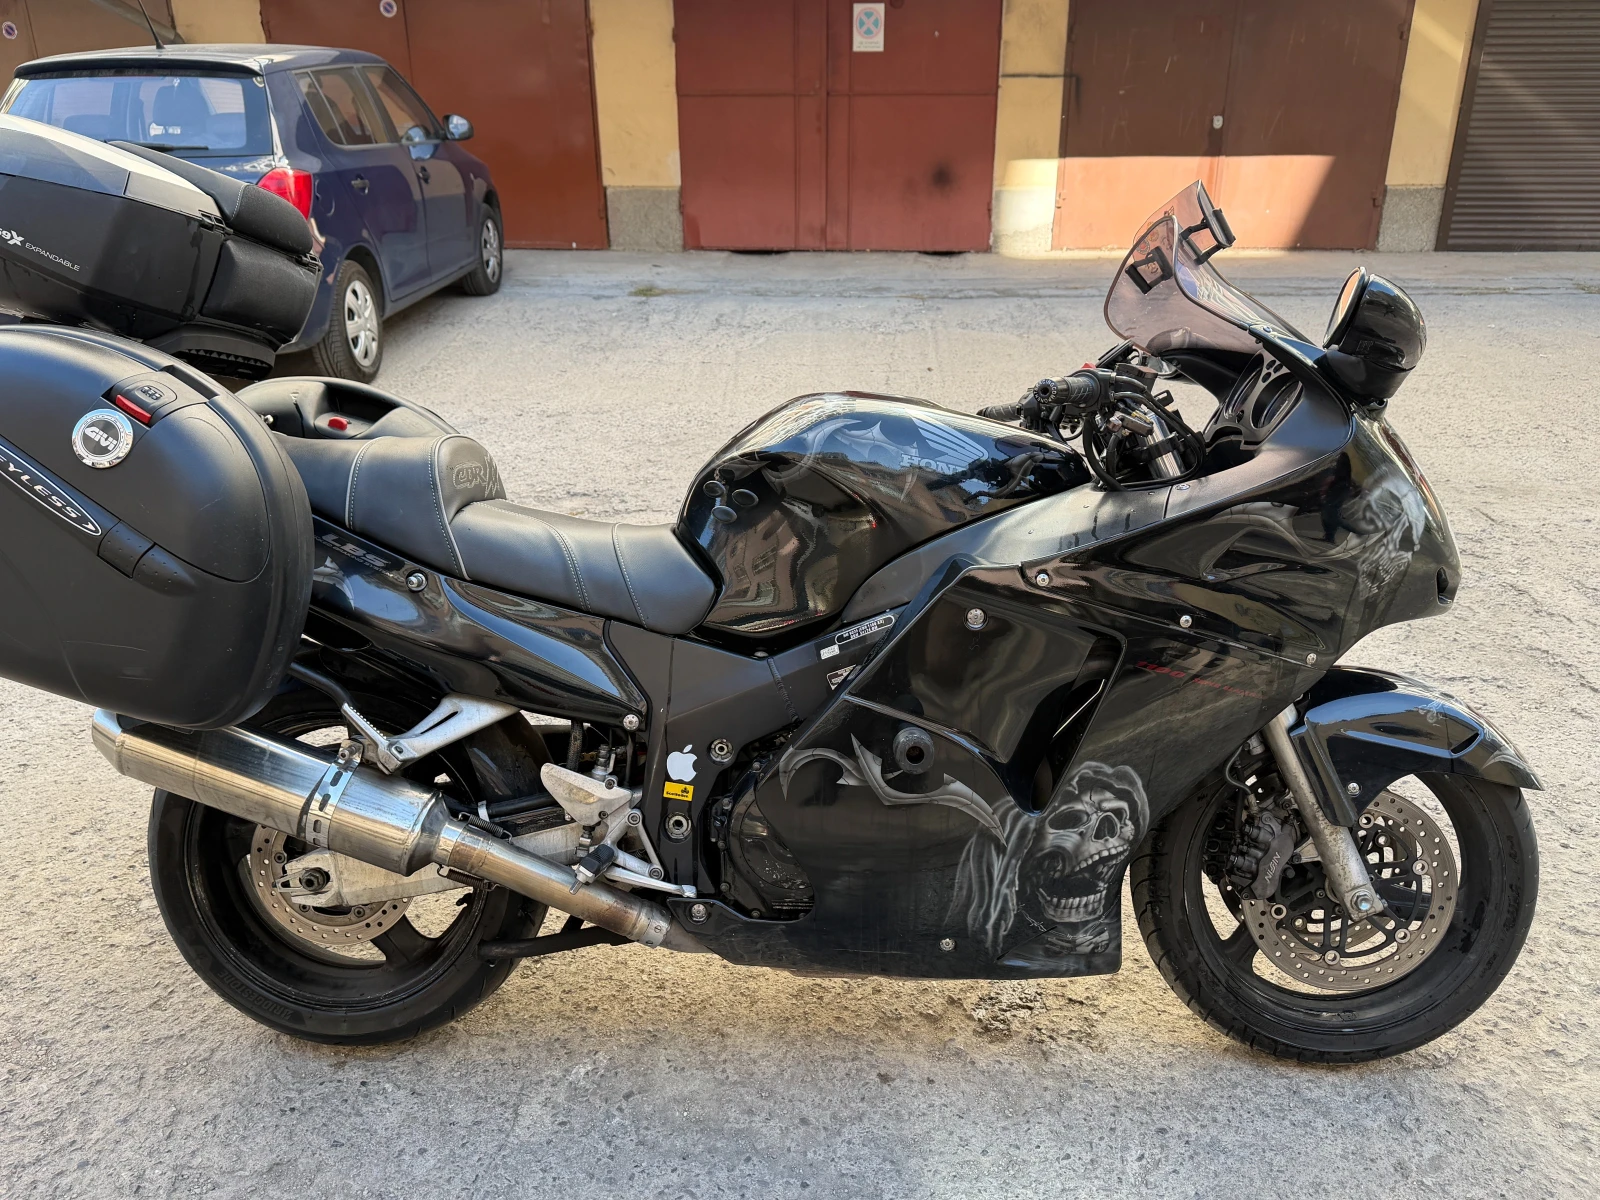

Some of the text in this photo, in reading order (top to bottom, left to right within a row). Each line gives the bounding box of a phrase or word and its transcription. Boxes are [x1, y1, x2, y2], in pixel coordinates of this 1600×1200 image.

[0, 228, 81, 272] 9X EXPANDABLE
[84, 426, 118, 451] GIVI
[321, 533, 392, 567] LBS
[218, 969, 294, 1020] BRIDGESTONE
